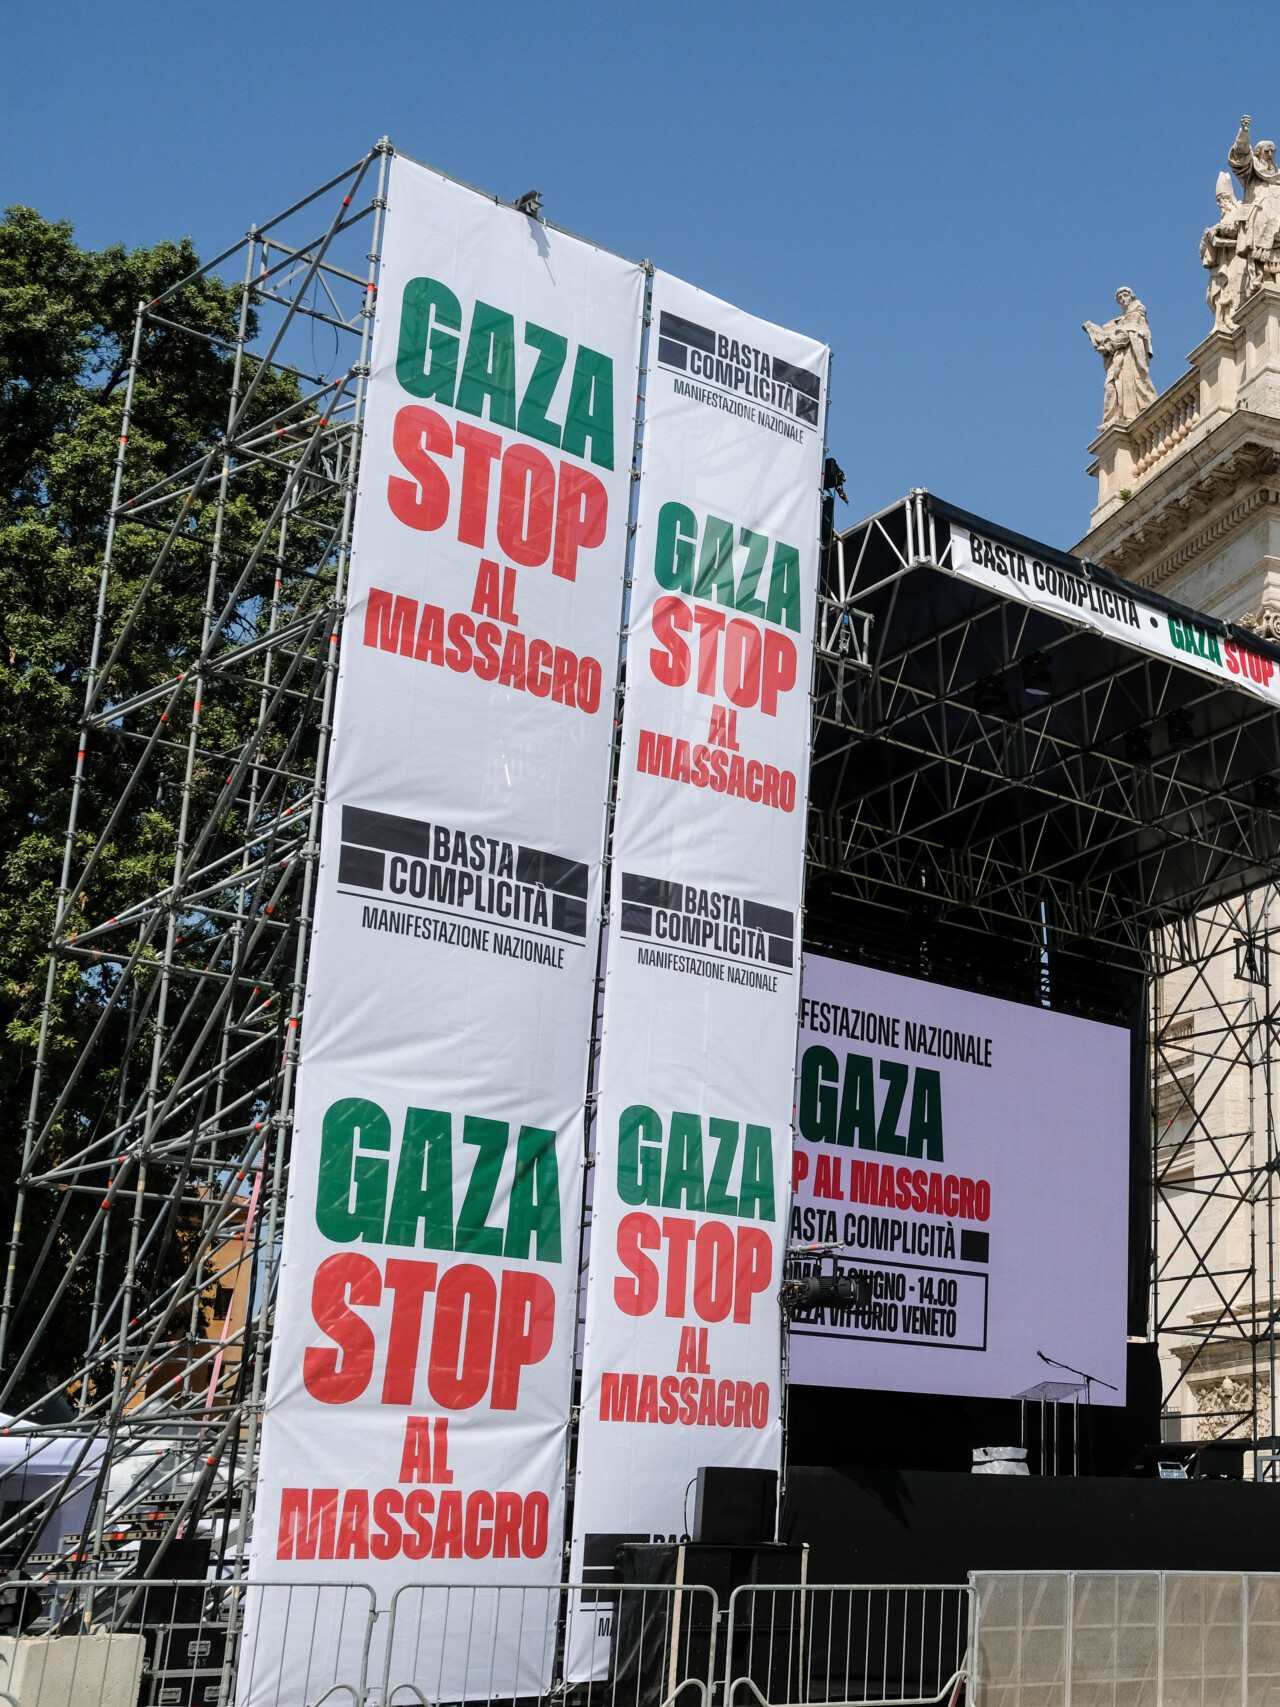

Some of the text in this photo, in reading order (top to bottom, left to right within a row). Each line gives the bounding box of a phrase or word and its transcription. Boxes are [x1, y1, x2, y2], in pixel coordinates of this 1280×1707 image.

[395, 276, 615, 471] GAZA
[690, 350, 794, 414] COMPLICITÀ
[718, 334, 771, 378] BASTA
[674, 379, 804, 444] MANIFESTAZIONE NAZIONALE
[387, 404, 608, 582] STOP
[472, 558, 518, 628] AL
[654, 501, 801, 633] GAZA
[969, 532, 1029, 586] BASTA
[1167, 614, 1224, 668] GAZA
[1224, 638, 1275, 688] STOP
[363, 587, 602, 714] MASSACRO
[649, 595, 798, 717] STOP
[708, 703, 740, 752] AL
[636, 729, 797, 813] MASSACRO
[433, 824, 514, 880] BASTA
[389, 856, 548, 928] COMPLICITÀ
[684, 885, 742, 926] BASTA
[361, 905, 565, 970] MANIFESTAZIONE NAZIONALE
[655, 909, 766, 962] COMPLICITÀ
[637, 947, 778, 993] MANIFESTAZIONE NAZIONALE
[904, 1020, 993, 1068] NAZIONALE
[799, 1045, 944, 1163] GAZA
[315, 1096, 563, 1264] GAZA
[616, 1103, 776, 1222] GAZA
[813, 1154, 844, 1201] AL
[849, 1159, 991, 1222] MASSACRO
[613, 1211, 773, 1325] STOP
[844, 1213, 956, 1259] COMPLICITÀ
[902, 1305, 957, 1338] VENETO
[918, 1276, 958, 1308] 14.00
[303, 1251, 556, 1411] STOP
[677, 1325, 710, 1375] AL
[599, 1372, 769, 1431] MASSACRO
[398, 1415, 454, 1484] AL
[276, 1487, 549, 1561] MASSACRO
